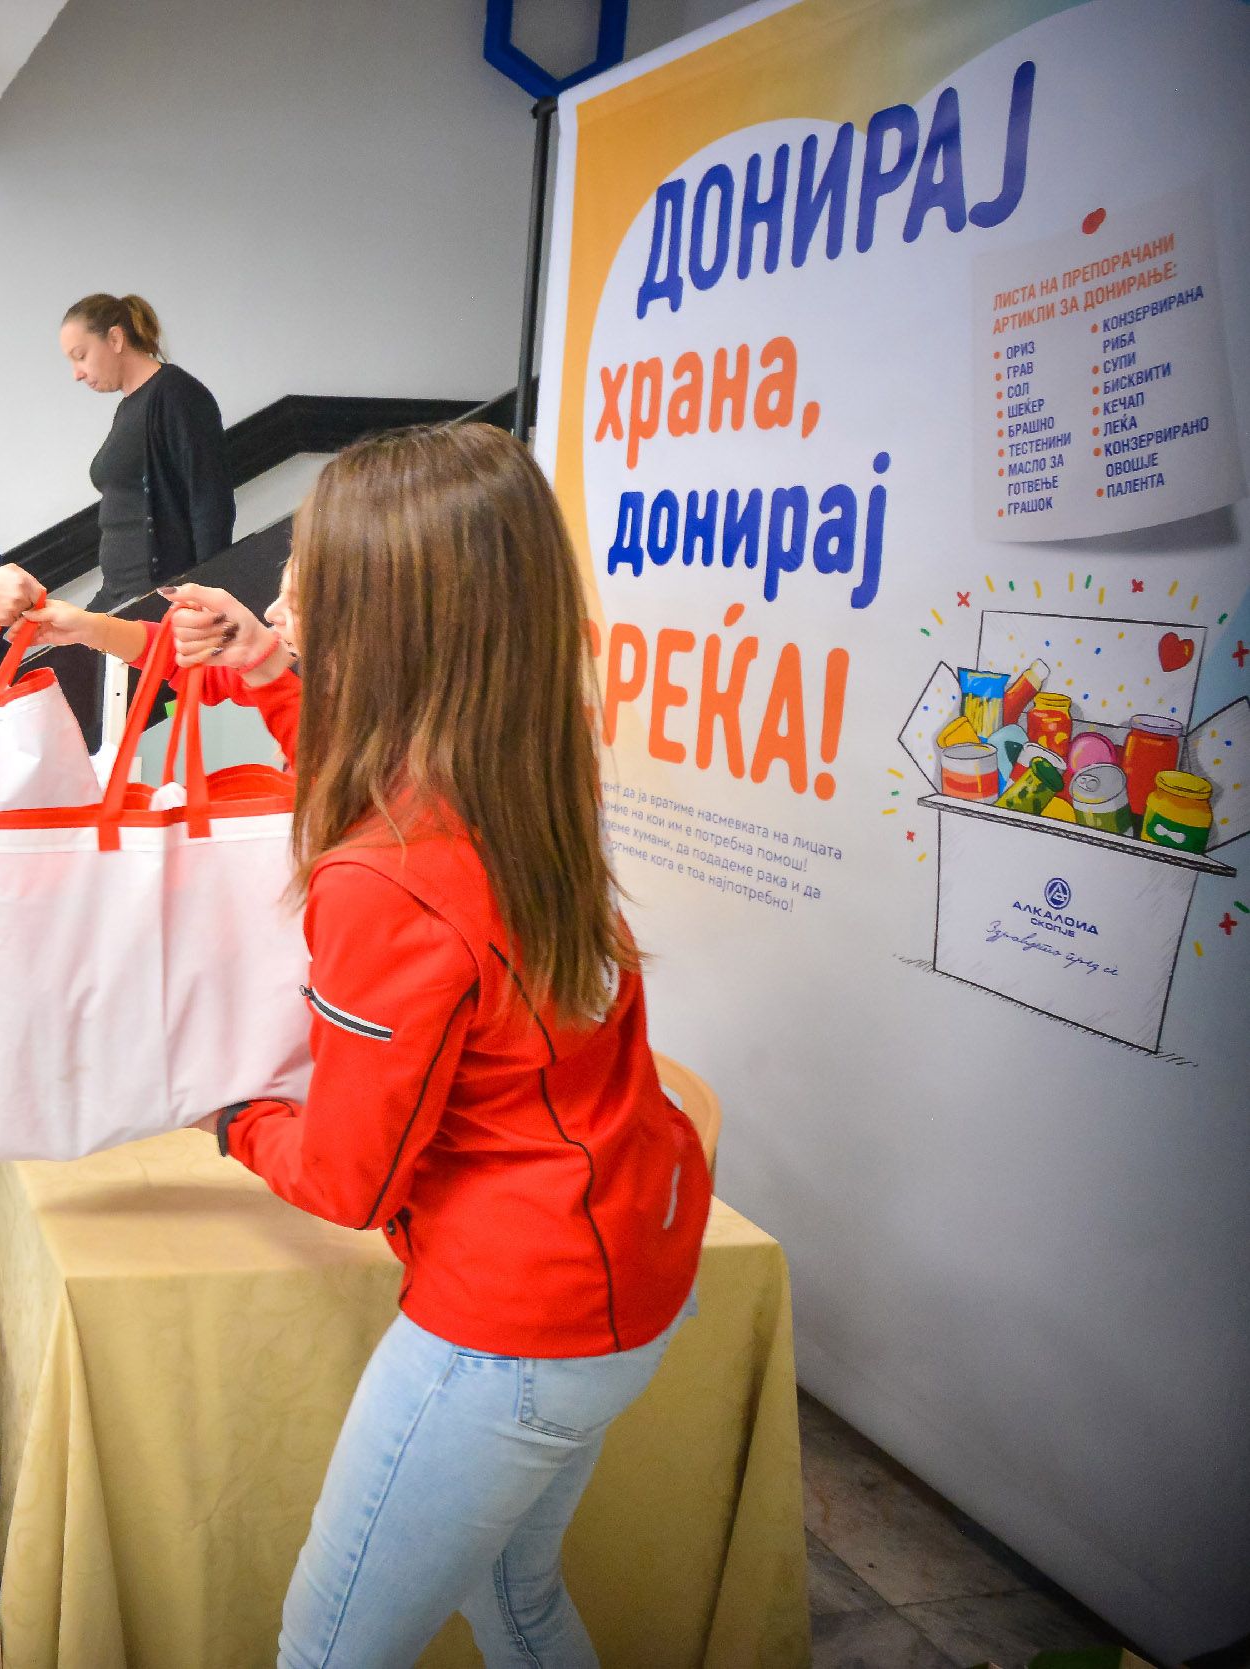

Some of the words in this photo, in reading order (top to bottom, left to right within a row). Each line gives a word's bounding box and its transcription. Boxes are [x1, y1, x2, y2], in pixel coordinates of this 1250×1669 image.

[636, 60, 1036, 320] ДОНИРАЈ
[993, 284, 1036, 311] ЛИСТА
[1040, 277, 1059, 297] НА
[1062, 233, 1175, 290] ПРЕПОРАЧАНИ
[992, 302, 1055, 335] АРТИКЛИ
[1060, 296, 1079, 316] ЗА
[1083, 261, 1178, 312] ДОНИРАЊЕ:
[1102, 285, 1205, 332] КОНЗЕРВИРАНА
[1006, 341, 1035, 360] ОРИЗ
[1102, 331, 1136, 354] РИБА
[1007, 362, 1034, 379] ГРАВ
[1103, 352, 1137, 374] СУПИ
[1007, 382, 1030, 399] СОЛ
[1103, 362, 1172, 395] БИСКВИТИ
[594, 336, 821, 469] храна,
[1007, 397, 1045, 419] ШЕЌЕР
[1103, 391, 1145, 416] КЕЧАП
[1008, 416, 1054, 438] БРАШНО
[1103, 412, 1138, 437] ЛЕЌА
[1104, 416, 1209, 458] КОНЗЕРВИРАНО
[1008, 432, 1072, 457] ТЕСТЕНИНИ
[1008, 457, 1046, 477] МАСЛО
[1050, 454, 1064, 469] ЗА
[1106, 452, 1159, 478] ОВОШЈЕ
[1008, 475, 1059, 497] ГОТВЕЊЕ
[1107, 473, 1165, 498] ПАЛЕНТА
[1007, 497, 1053, 516] ГРАШОК
[607, 451, 891, 610] донирај
[586, 603, 849, 801] РЕЌА!
[623, 788, 635, 799] да
[650, 795, 695, 816] вратиме
[697, 808, 769, 838] насмевката
[773, 831, 789, 844] на
[793, 836, 842, 860] лицата
[631, 809, 644, 820] на
[647, 815, 665, 828] кои
[668, 821, 683, 831] им
[685, 826, 692, 837] е
[695, 828, 753, 855] потребна
[757, 847, 808, 873] помош!
[651, 854, 674, 870] кога
[677, 863, 684, 873] е
[688, 866, 705, 881] тоа
[676, 843, 690, 856] да
[693, 848, 753, 877] подадеме
[757, 869, 788, 888] рака
[791, 881, 800, 892] и
[803, 885, 821, 899] да
[1030, 918, 1076, 938] СКОПЈЕ
